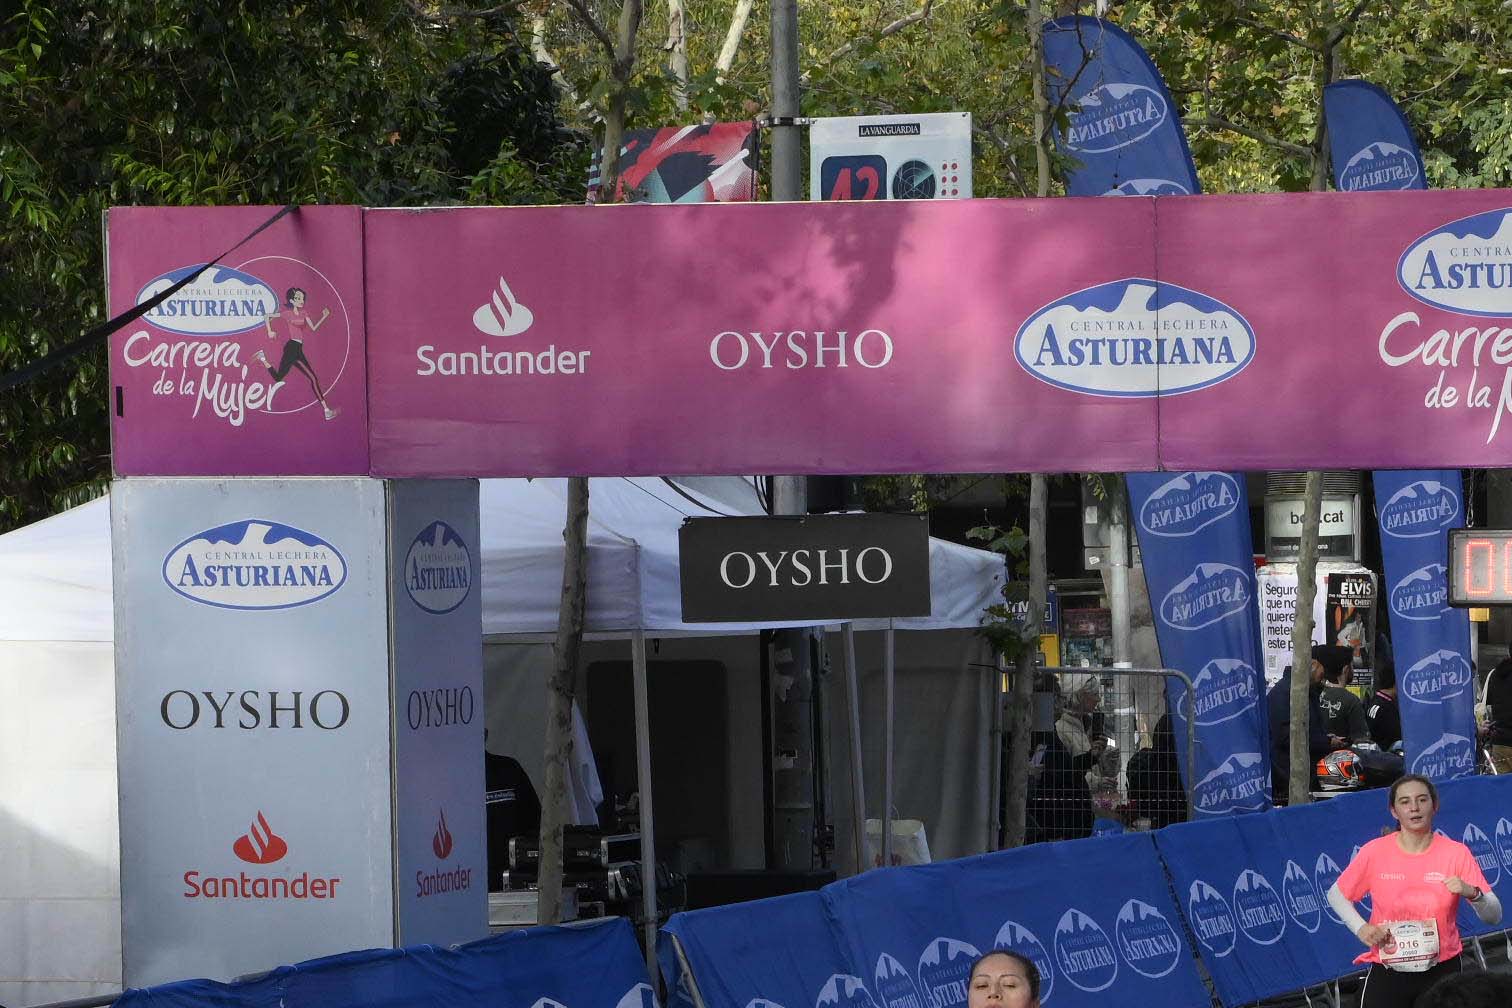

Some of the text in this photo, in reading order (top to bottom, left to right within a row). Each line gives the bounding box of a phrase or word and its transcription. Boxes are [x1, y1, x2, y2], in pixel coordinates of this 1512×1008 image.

[869, 124, 919, 136] VANGUARDIA
[148, 291, 267, 317] ASTURIANA
[170, 288, 213, 297] ENTRAL
[1070, 319, 1229, 333] CENTRAL LECHERA
[123, 331, 242, 369] Carrera
[417, 345, 590, 375] Santander
[710, 329, 894, 370] OYSHO
[1033, 323, 1237, 368] ASTURIANA
[153, 369, 195, 396] de la
[192, 364, 286, 427] Mujer
[1425, 371, 1491, 409] de la
[177, 553, 334, 588] ASTURIANA
[205, 551, 328, 560] CENTRAL LECHERA
[720, 547, 893, 589] OYSHO
[410, 555, 469, 591] ASTURIANA
[1341, 582, 1371, 595] ELVIS
[1266, 602, 1283, 611] que
[1268, 640, 1286, 649] este
[159, 689, 350, 731] OYSHO
[407, 686, 474, 730] OYSHO
[183, 870, 340, 899] Santander
[416, 867, 472, 898] Santander
[1399, 939, 1419, 949] 016
